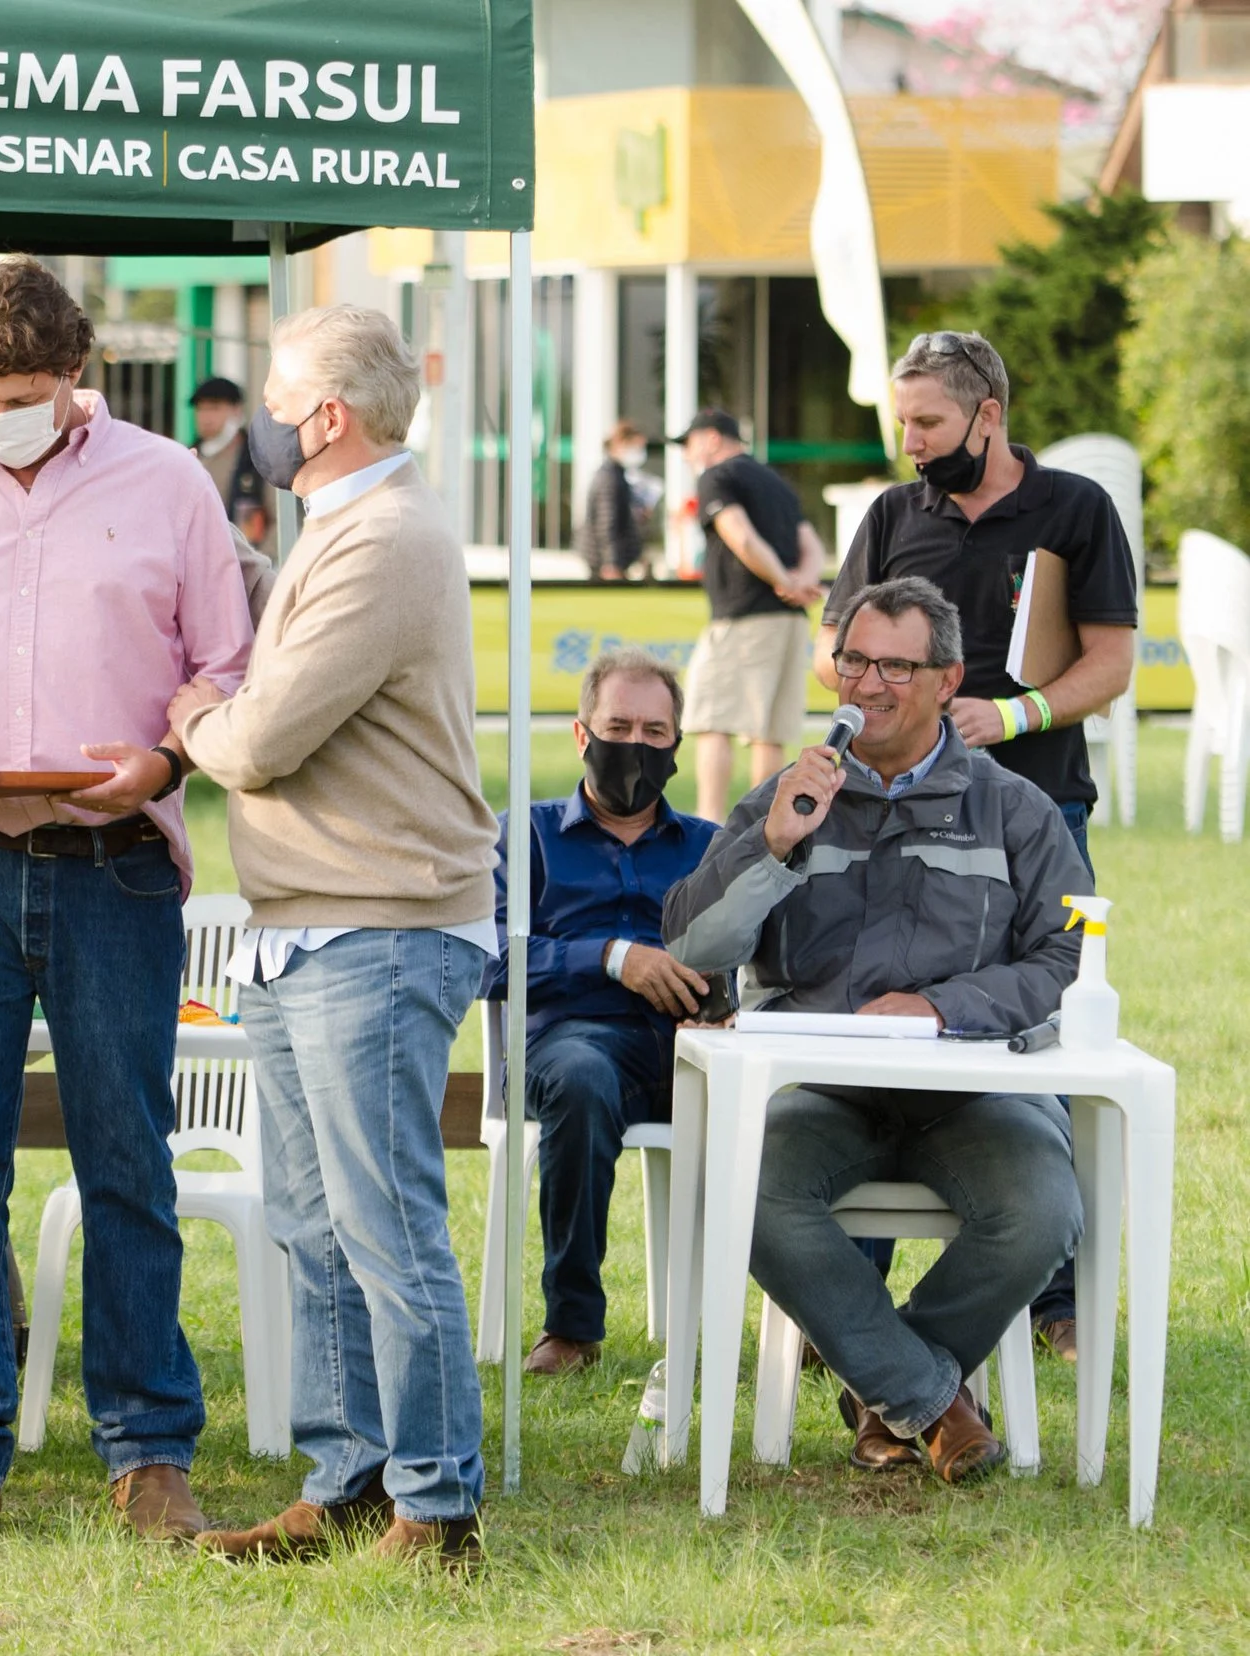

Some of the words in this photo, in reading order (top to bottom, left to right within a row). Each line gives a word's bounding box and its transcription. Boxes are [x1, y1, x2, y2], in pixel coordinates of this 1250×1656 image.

[161, 59, 461, 125] FARSUL
[177, 143, 301, 183] CASA
[311, 146, 461, 190] RURAL
[939, 831, 976, 842] Columbia
